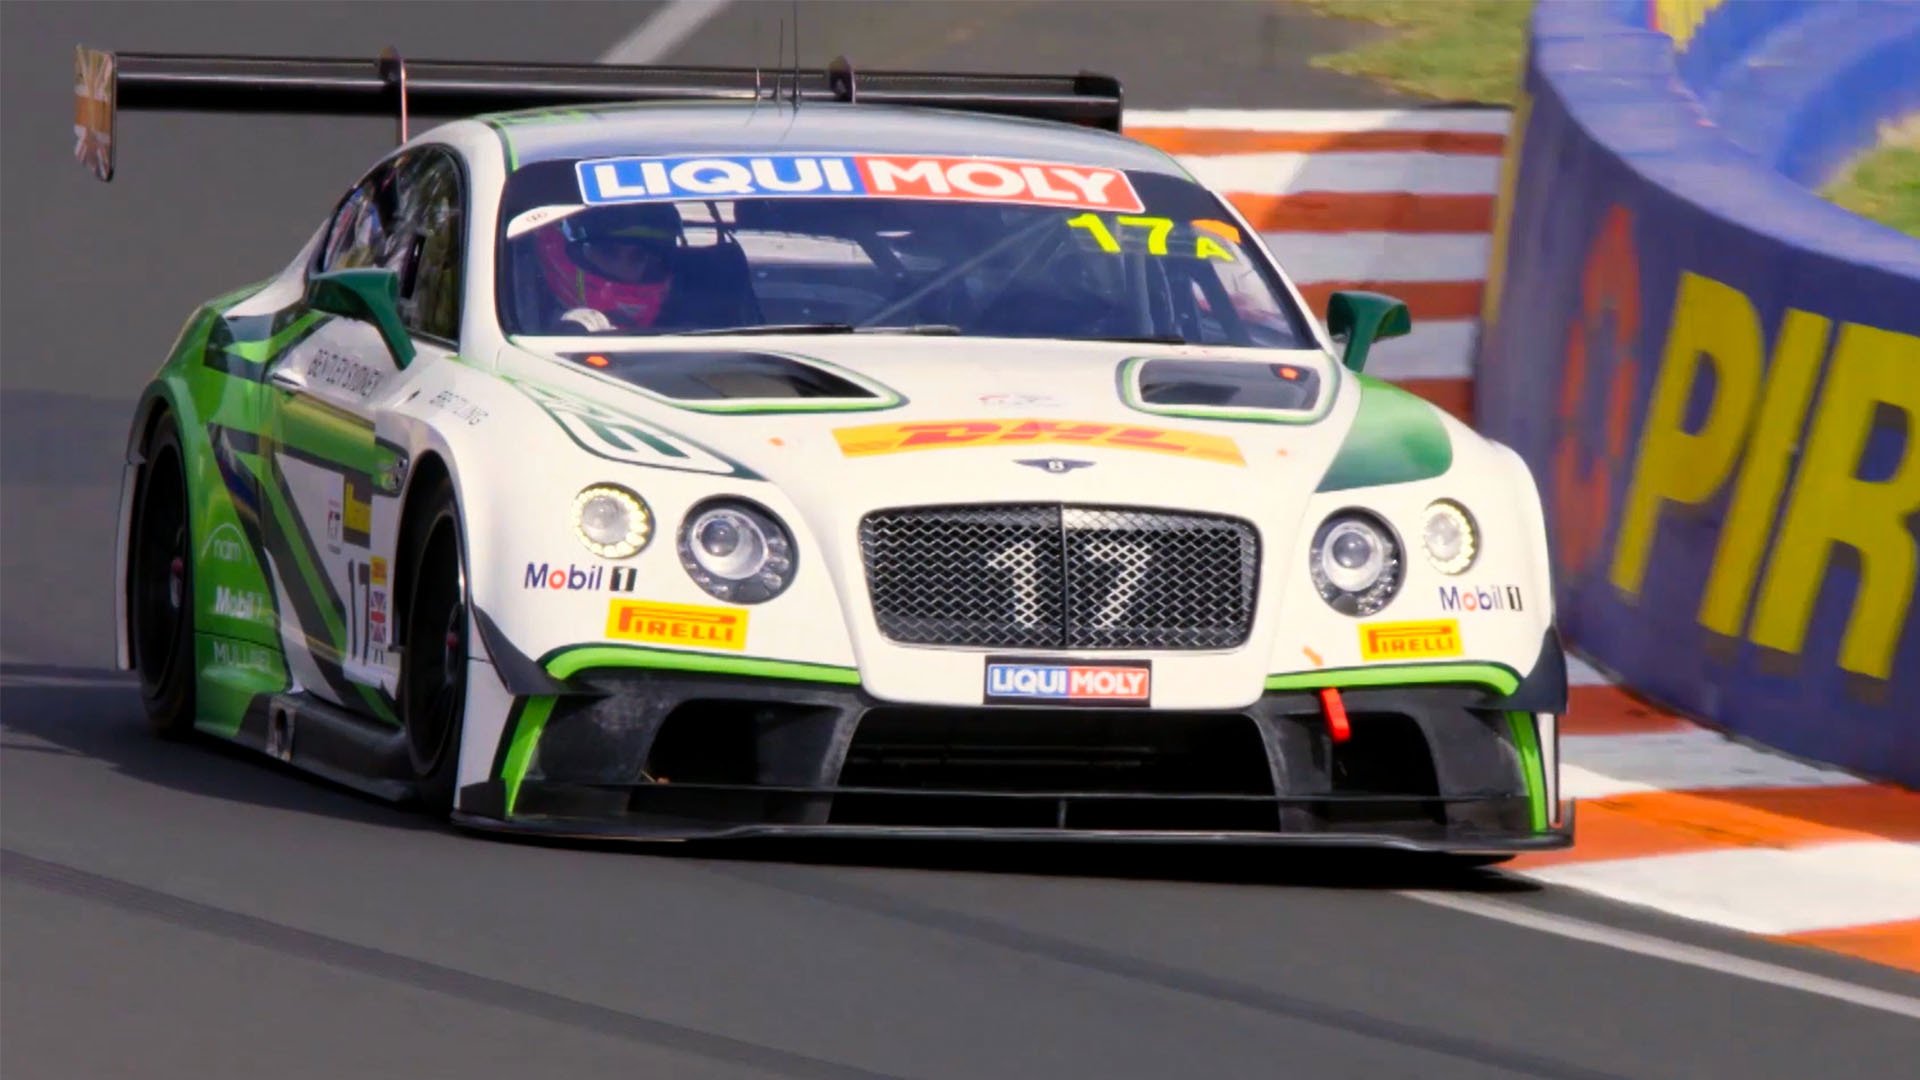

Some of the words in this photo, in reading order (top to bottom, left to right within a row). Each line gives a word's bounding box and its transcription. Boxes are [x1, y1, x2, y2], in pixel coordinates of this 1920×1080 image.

[594, 157, 854, 199] LIQUI
[866, 158, 1116, 203] MOLY
[1066, 213, 1174, 255] 17
[1196, 235, 1235, 262] A
[898, 420, 1188, 452] DHL
[1609, 268, 1920, 681] PIR
[524, 562, 603, 590] Mobil
[611, 566, 635, 592] 1
[986, 539, 1151, 629] 17
[214, 585, 254, 620] Mobil
[348, 558, 370, 666] 17
[1438, 585, 1504, 612] Mobil
[617, 606, 737, 642] PIRELLI
[1367, 624, 1455, 654] PIRELLI
[992, 667, 1067, 695] LIQUI
[1071, 670, 1146, 696] MOLY
